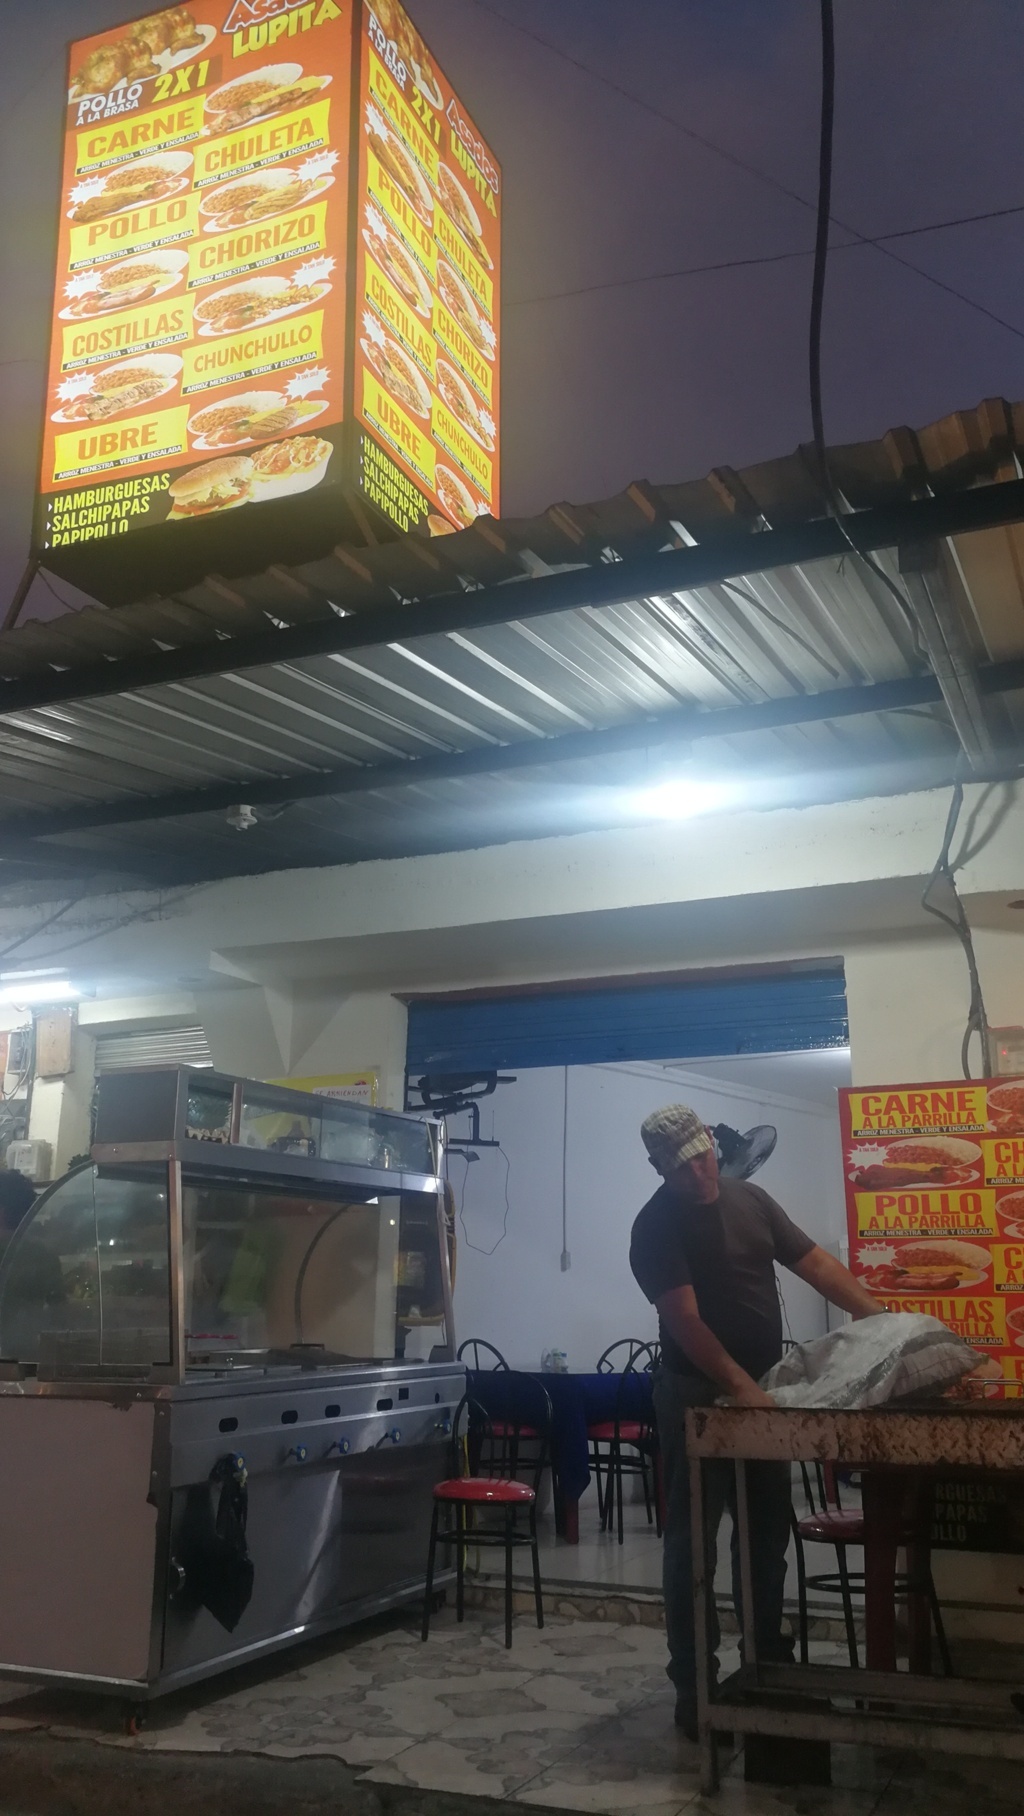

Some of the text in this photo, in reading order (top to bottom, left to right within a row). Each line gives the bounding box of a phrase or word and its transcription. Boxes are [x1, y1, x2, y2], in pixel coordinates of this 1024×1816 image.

[232, 0, 342, 58] LUPITA
[369, 14, 406, 82] POLLO
[78, 60, 210, 116] POLLO 2X1
[76, 100, 138, 126] A LA BRASA
[88, 107, 194, 158] CARNE
[376, 70, 434, 174] CARNE
[411, 86, 440, 145] 2X1
[198, 176, 220, 186] ARROZ
[220, 164, 254, 179] MENESTRA
[260, 154, 280, 166] VERDE
[288, 138, 324, 156] ENSALADA
[204, 117, 314, 172] CHULETA
[450, 129, 497, 218] LUPITA
[88, 200, 187, 246] POLLO
[378, 166, 431, 258] POLLO
[192, 276, 214, 287] ARROZ
[214, 265, 250, 280] MENESTRA
[256, 256, 276, 267] VERDE
[284, 242, 320, 258] ENSALADA
[200, 214, 315, 270] CHORIZO
[440, 218, 487, 302] CHULETA
[72, 309, 184, 357] COSTILLAS
[372, 274, 432, 366] COSTILLAS
[186, 382, 208, 392] ARROZ
[210, 372, 245, 386] MENESTRA
[251, 365, 272, 376] VERDE
[280, 352, 316, 367] ENSALADA
[194, 325, 312, 372] CHUNCHULLO
[438, 308, 488, 388] CHORIZO
[78, 422, 158, 460] UBRE
[378, 393, 421, 460] UBRE
[437, 410, 488, 480] CHUNCHULLO
[58, 468, 80, 478] ARROZ
[80, 461, 114, 474] MENESTRA
[120, 454, 140, 464] VERDE
[147, 445, 182, 458] ENSALADA
[364, 436, 428, 516] HAMBURGUESAS
[52, 496, 150, 532] SALCHIPAPAS
[54, 473, 170, 514] HAMBURGUESAS
[364, 456, 419, 524] SALCHIPAPAS
[364, 476, 408, 532] PAPIPOLLO
[862, 1090, 976, 1116] CARNE
[862, 1112, 976, 1129] A LA PARRILLA
[880, 1128, 914, 1136] MENESTRA
[948, 1124, 984, 1132] ENSALADA
[996, 1164, 1024, 1176] A L
[868, 1214, 986, 1230] A LA PARRILLA
[875, 1192, 982, 1216] POLLO
[1004, 1247, 1024, 1270] C
[1006, 1270, 1018, 1283] A
[884, 1300, 994, 1322] OSTILLAS
[944, 1322, 996, 1336] RILLA
